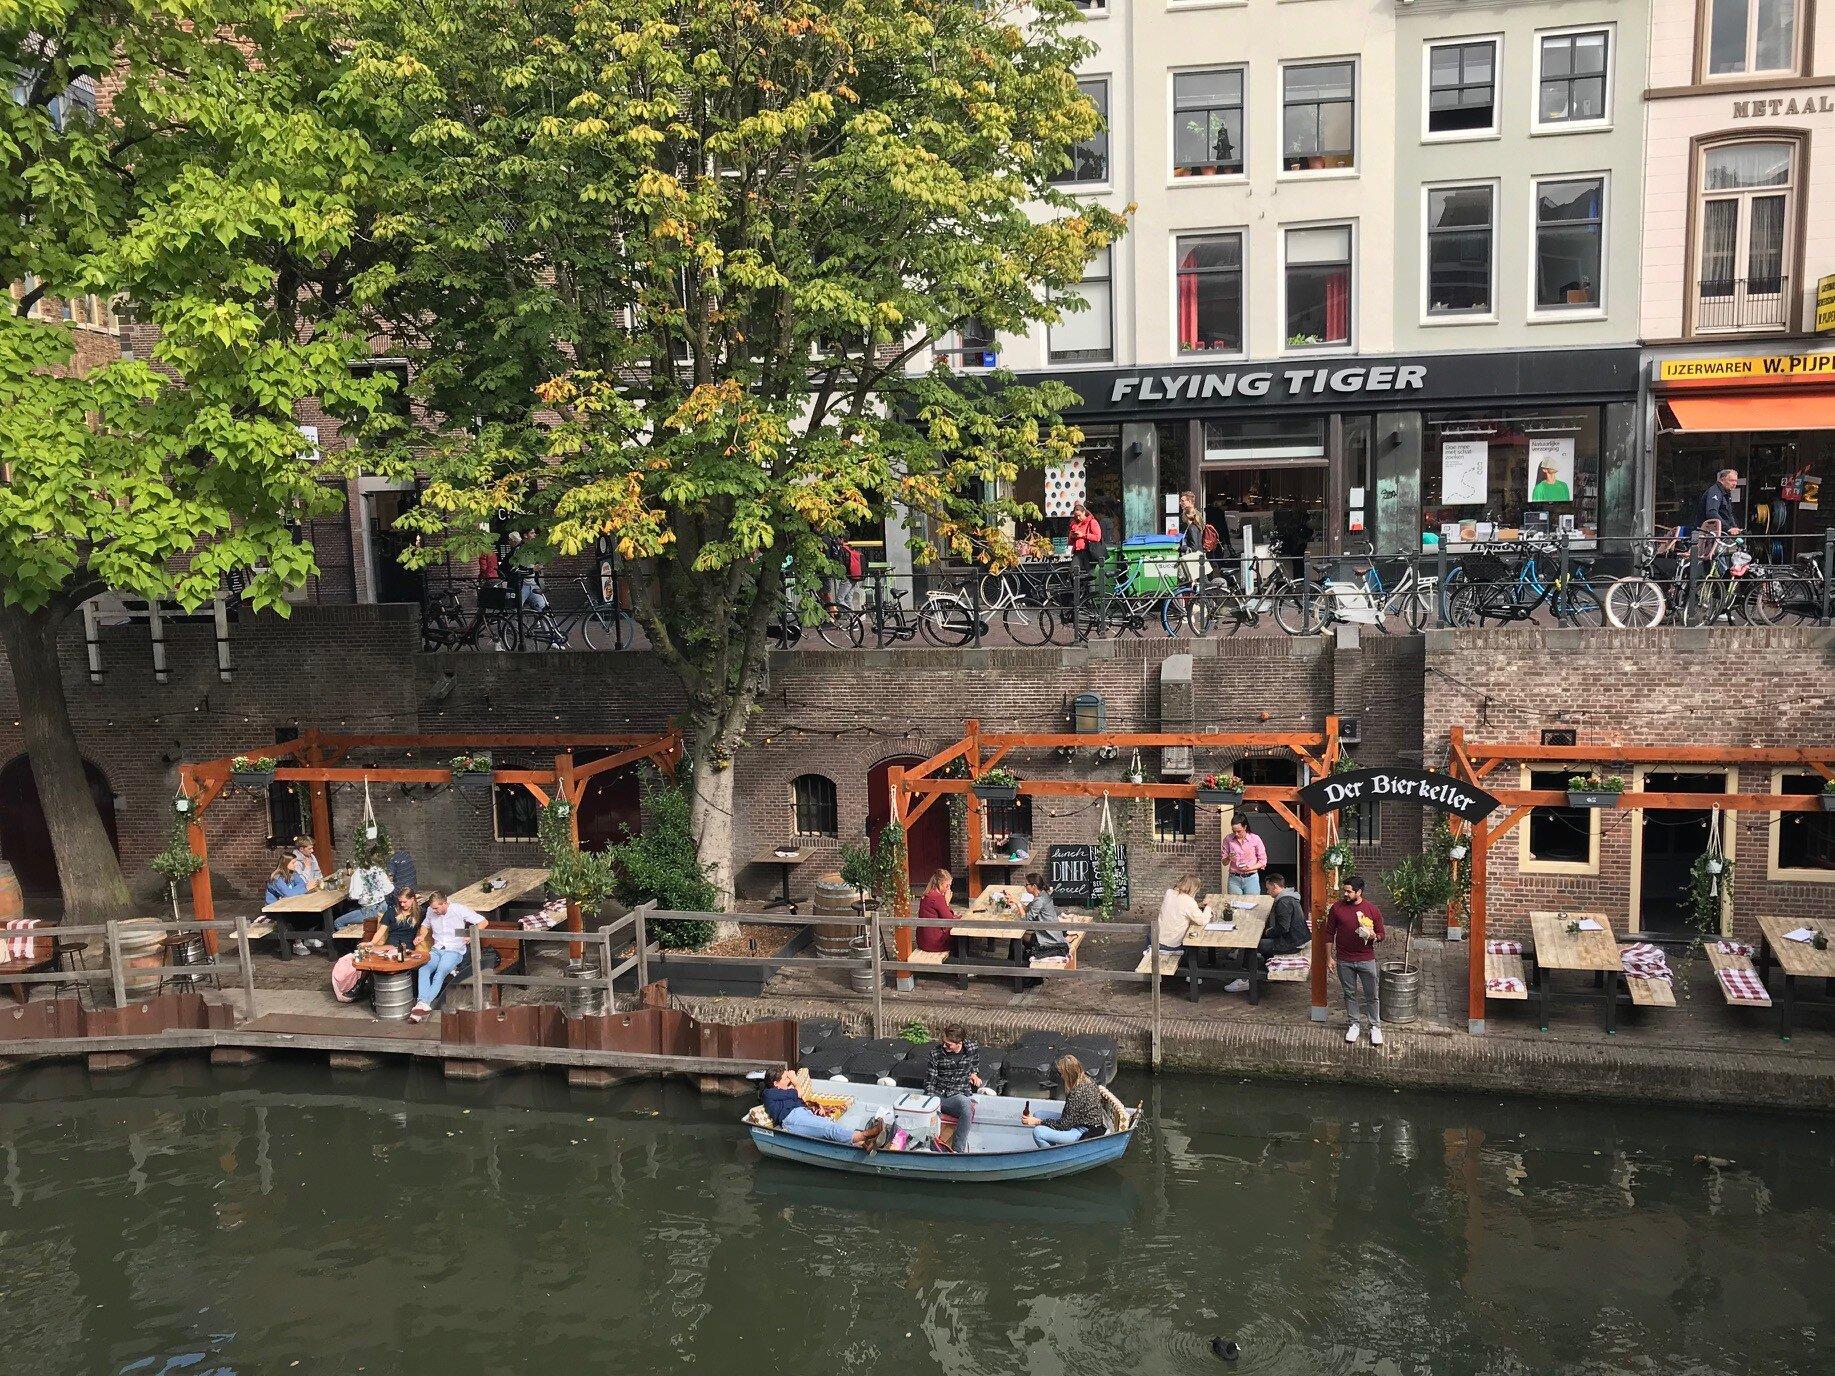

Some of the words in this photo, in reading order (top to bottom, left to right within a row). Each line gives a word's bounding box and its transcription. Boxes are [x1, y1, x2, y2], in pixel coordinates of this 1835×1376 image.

[1733, 96, 1835, 118] METAAL
[1667, 361, 1752, 376] IJZERWAREN
[1789, 355, 1835, 372] PIJP
[1110, 372, 1273, 401] FLYING
[1284, 365, 1427, 394] TIGER
[1324, 780, 1364, 804] Der
[1371, 774, 1476, 811] Bierkeller
[1051, 847, 1089, 858] lunch
[1052, 860, 1090, 882] DINER
